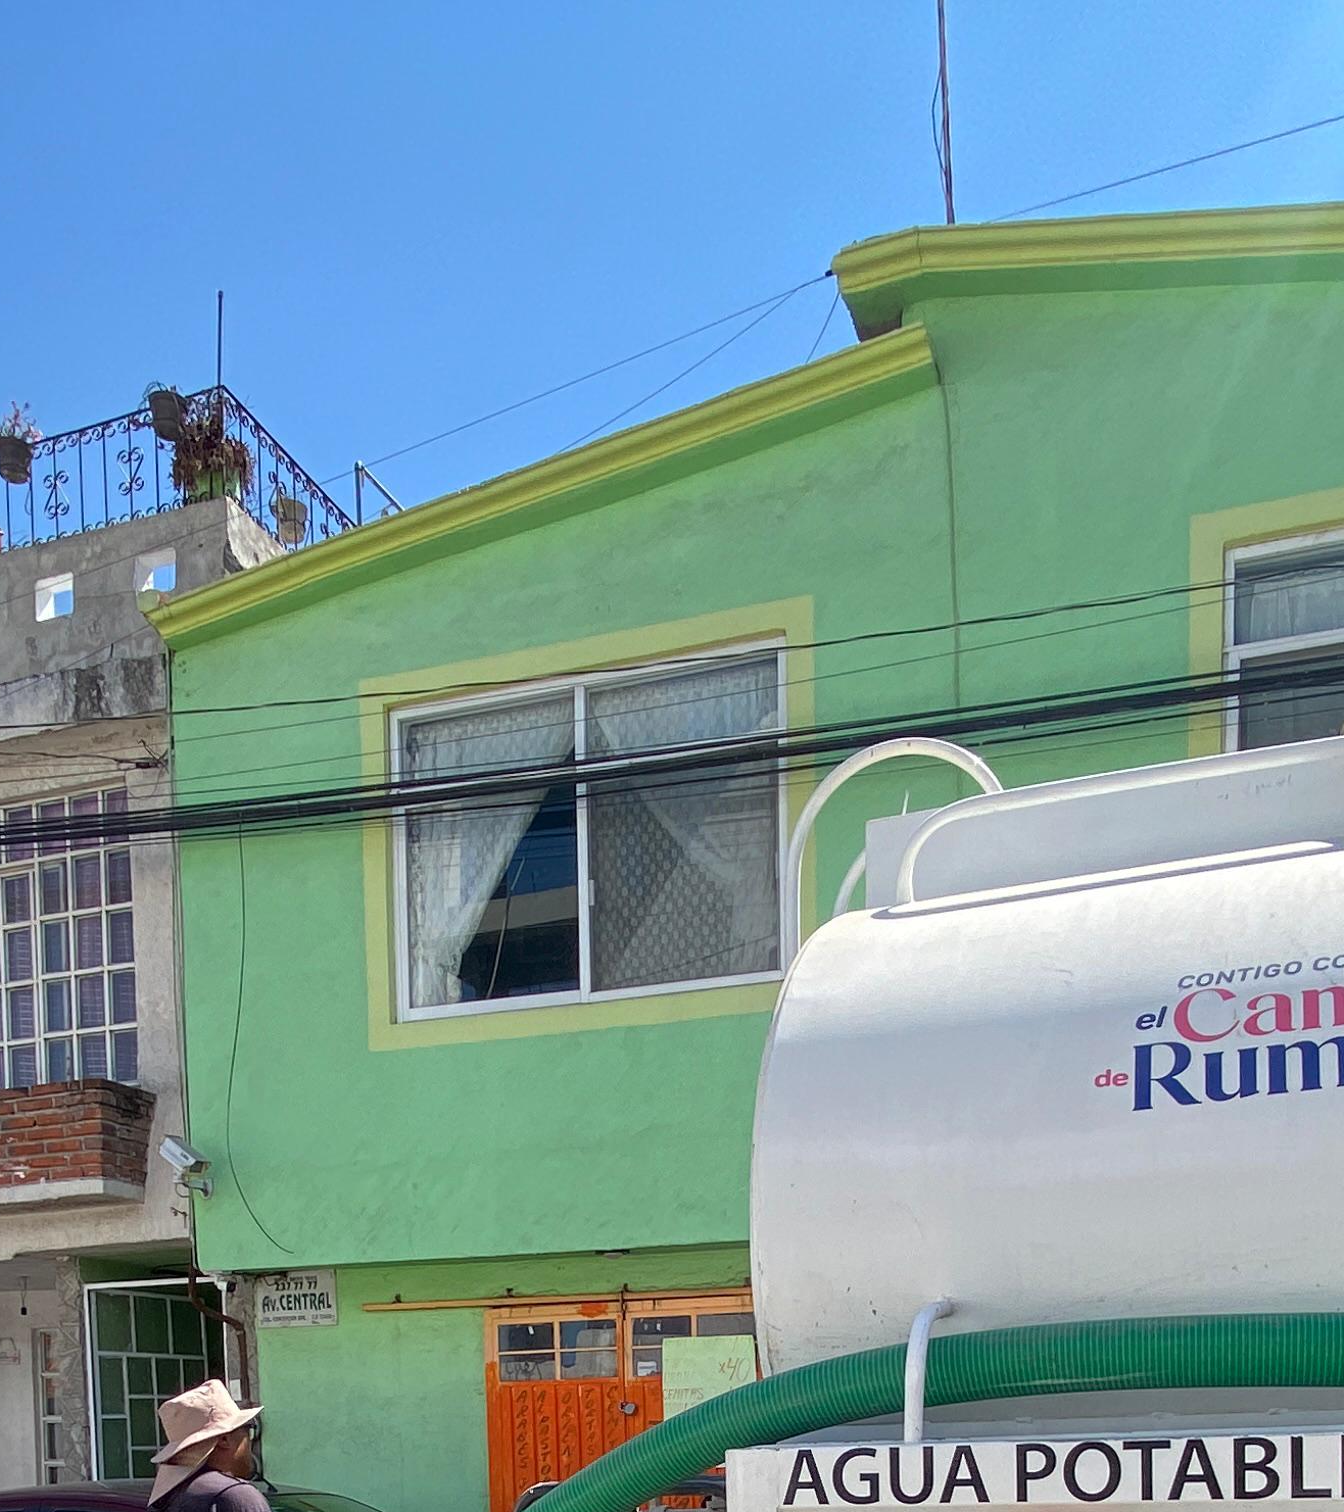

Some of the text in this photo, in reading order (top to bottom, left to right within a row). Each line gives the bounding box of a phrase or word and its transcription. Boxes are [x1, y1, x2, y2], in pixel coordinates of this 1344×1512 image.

[1177, 959, 1303, 990] CONTIGO
[1135, 1006, 1167, 1032] el
[1094, 1069, 1129, 1089] de
[783, 1445, 991, 1506] AGUA
